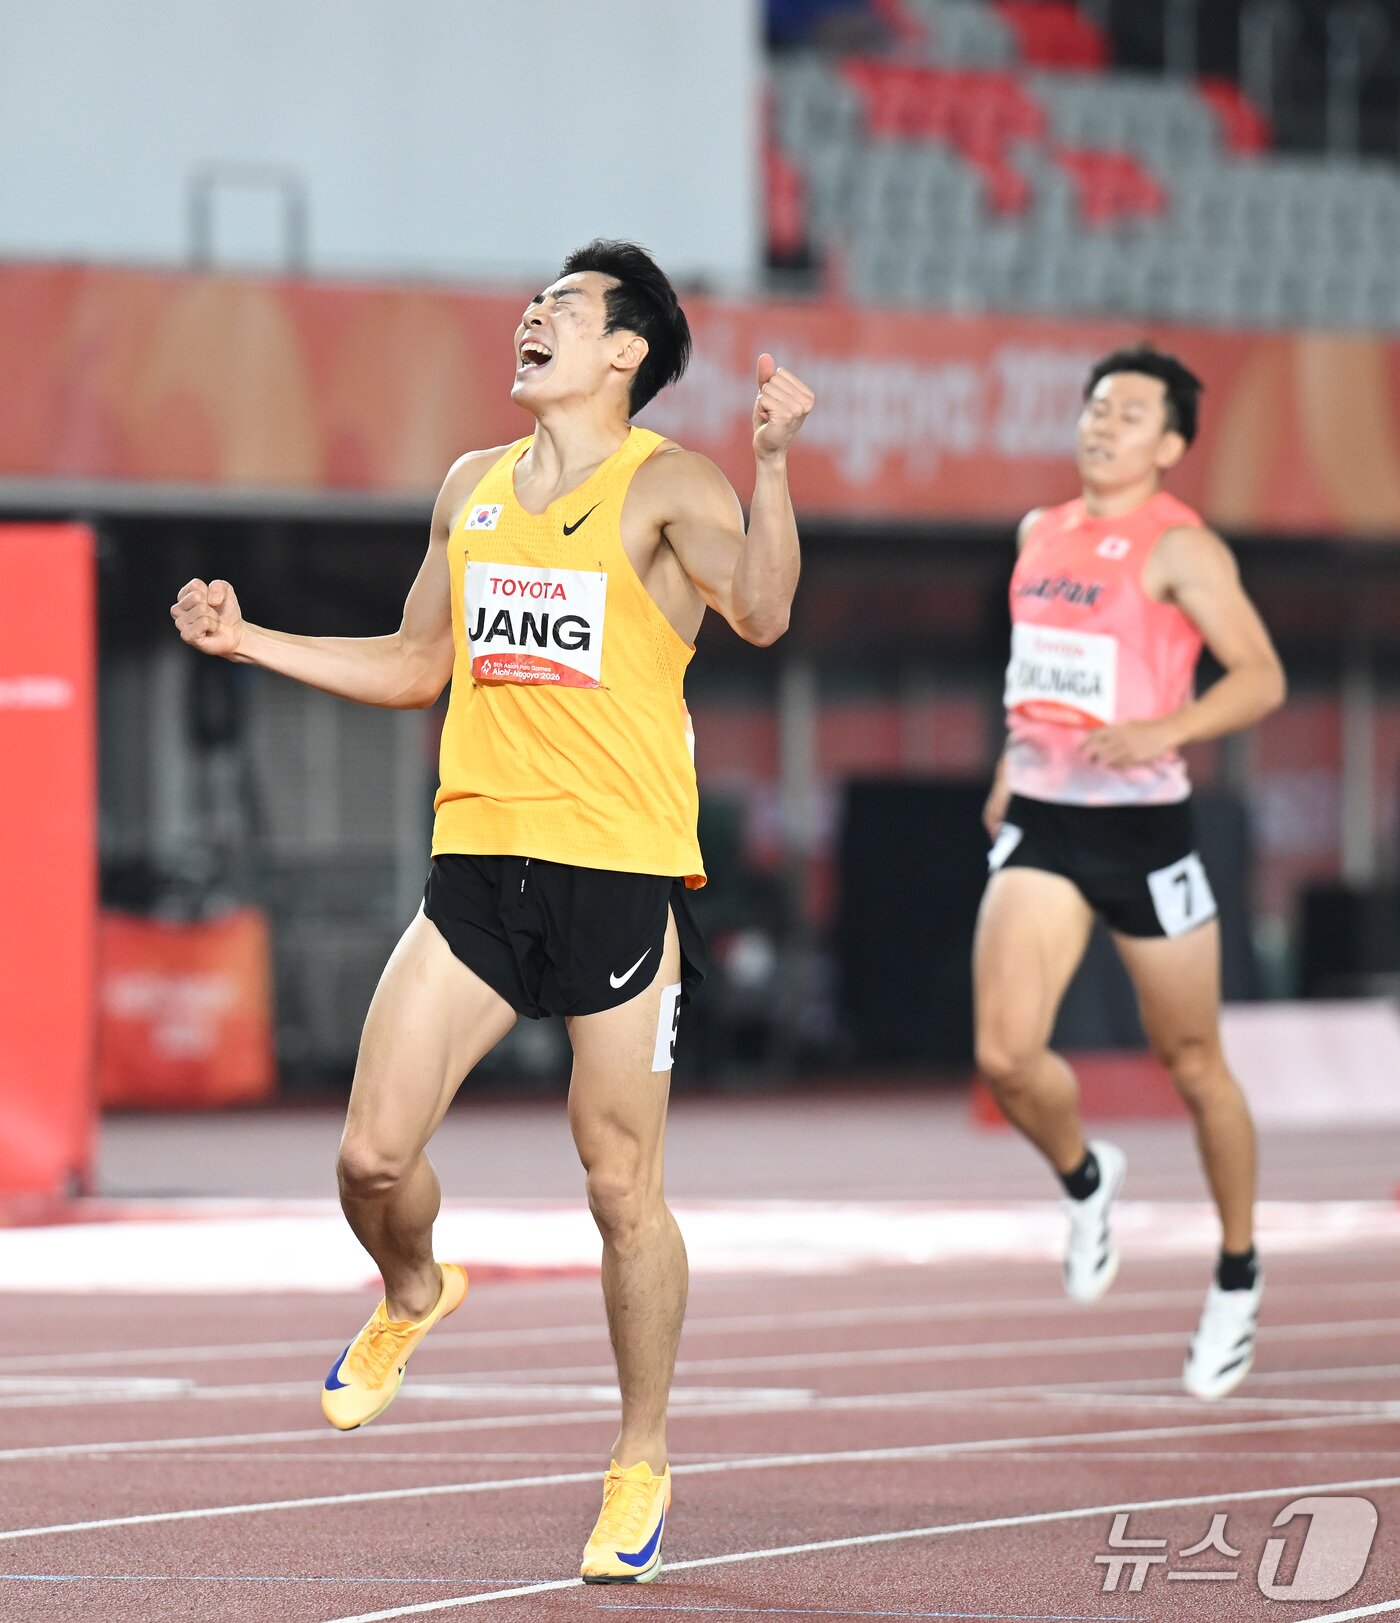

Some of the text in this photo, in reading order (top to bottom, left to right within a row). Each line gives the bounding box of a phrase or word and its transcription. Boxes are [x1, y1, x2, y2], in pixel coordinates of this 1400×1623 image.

[490, 577, 567, 600] TOYOTA
[468, 607, 591, 651] JANG
[492, 667, 560, 681] Aichi-Nagoya 2026
[503, 662, 519, 670] Asian
[1171, 870, 1193, 917] 7
